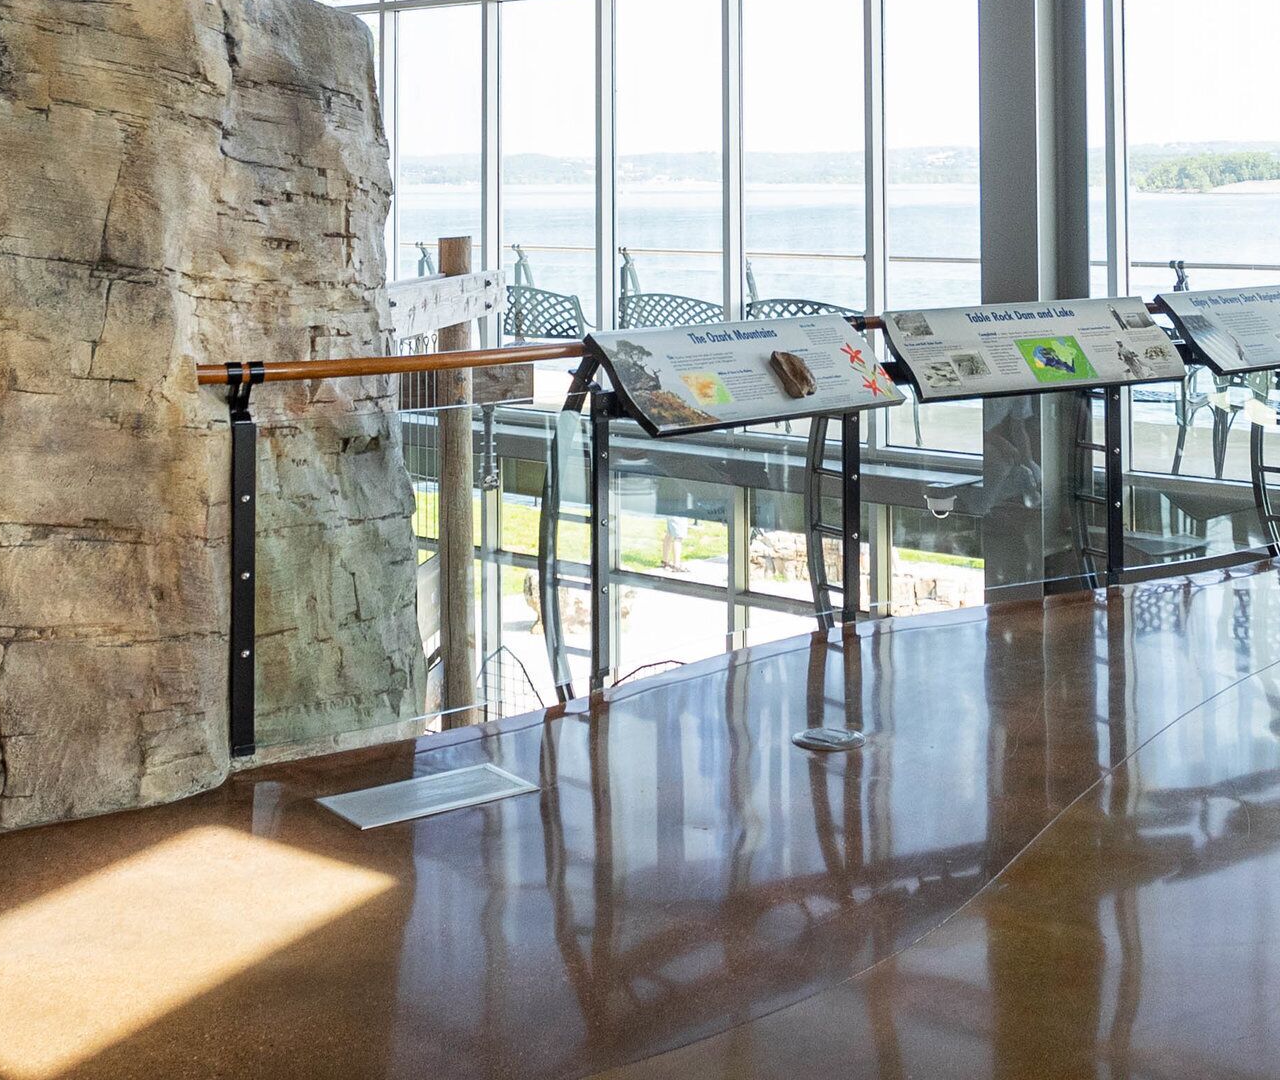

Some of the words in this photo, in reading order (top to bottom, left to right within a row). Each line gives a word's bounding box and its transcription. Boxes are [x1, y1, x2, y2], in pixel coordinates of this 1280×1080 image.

[1190, 298, 1211, 309] Enjoy
[1239, 293, 1260, 303] Short
[965, 311, 992, 323] Table
[990, 310, 1015, 322] Rock
[1013, 309, 1037, 320] Dam
[1036, 307, 1054, 319] and
[1052, 306, 1075, 318] Lake
[688, 333, 707, 344] The
[706, 330, 734, 343] Ozark
[733, 328, 777, 340] Mountains
